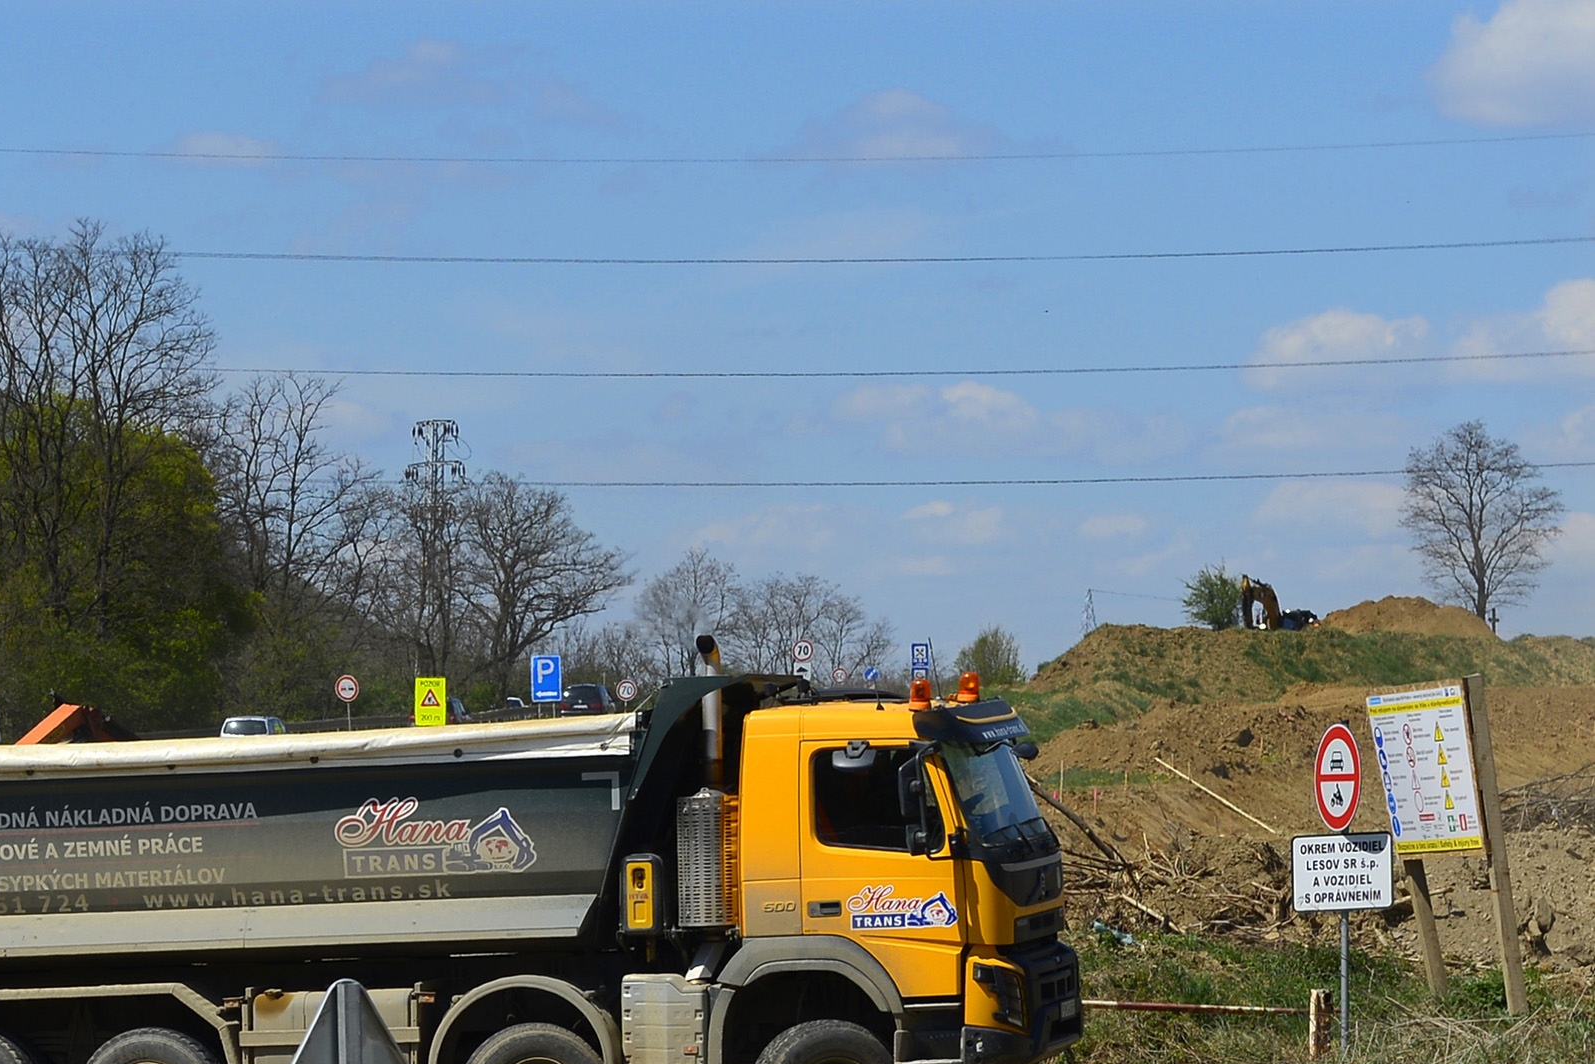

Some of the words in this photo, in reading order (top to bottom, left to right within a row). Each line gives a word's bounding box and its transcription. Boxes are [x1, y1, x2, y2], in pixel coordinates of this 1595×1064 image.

[798, 645, 809, 656] 70
[536, 658, 555, 684] P
[621, 685, 633, 696] 70
[45, 801, 154, 827] NÁKLADNÁ
[160, 802, 258, 823] DOPRAVA
[335, 797, 471, 848] Hana
[45, 842, 59, 859] A
[64, 834, 132, 859] ZEMNÉ
[138, 832, 203, 855] PRÁCE
[1300, 842, 1336, 855] OKREM
[1338, 840, 1385, 853] VOZIDIEL
[351, 853, 437, 873] TRANS
[1306, 859, 1340, 871] LESOV
[1343, 858, 1357, 869] SR
[1360, 858, 1379, 870] š.p.
[95, 864, 226, 888] MATERIÁLOV
[1313, 876, 1320, 887] A
[1323, 874, 1372, 886] VOZIDIEL
[38, 894, 90, 913] 724
[143, 879, 451, 909] www.hana-trans.sk
[846, 886, 921, 913] Hana
[1304, 893, 1311, 904] S
[1314, 887, 1381, 904] OPRÁVNENÍM
[763, 901, 797, 913] 500
[855, 916, 903, 928] TRANS
